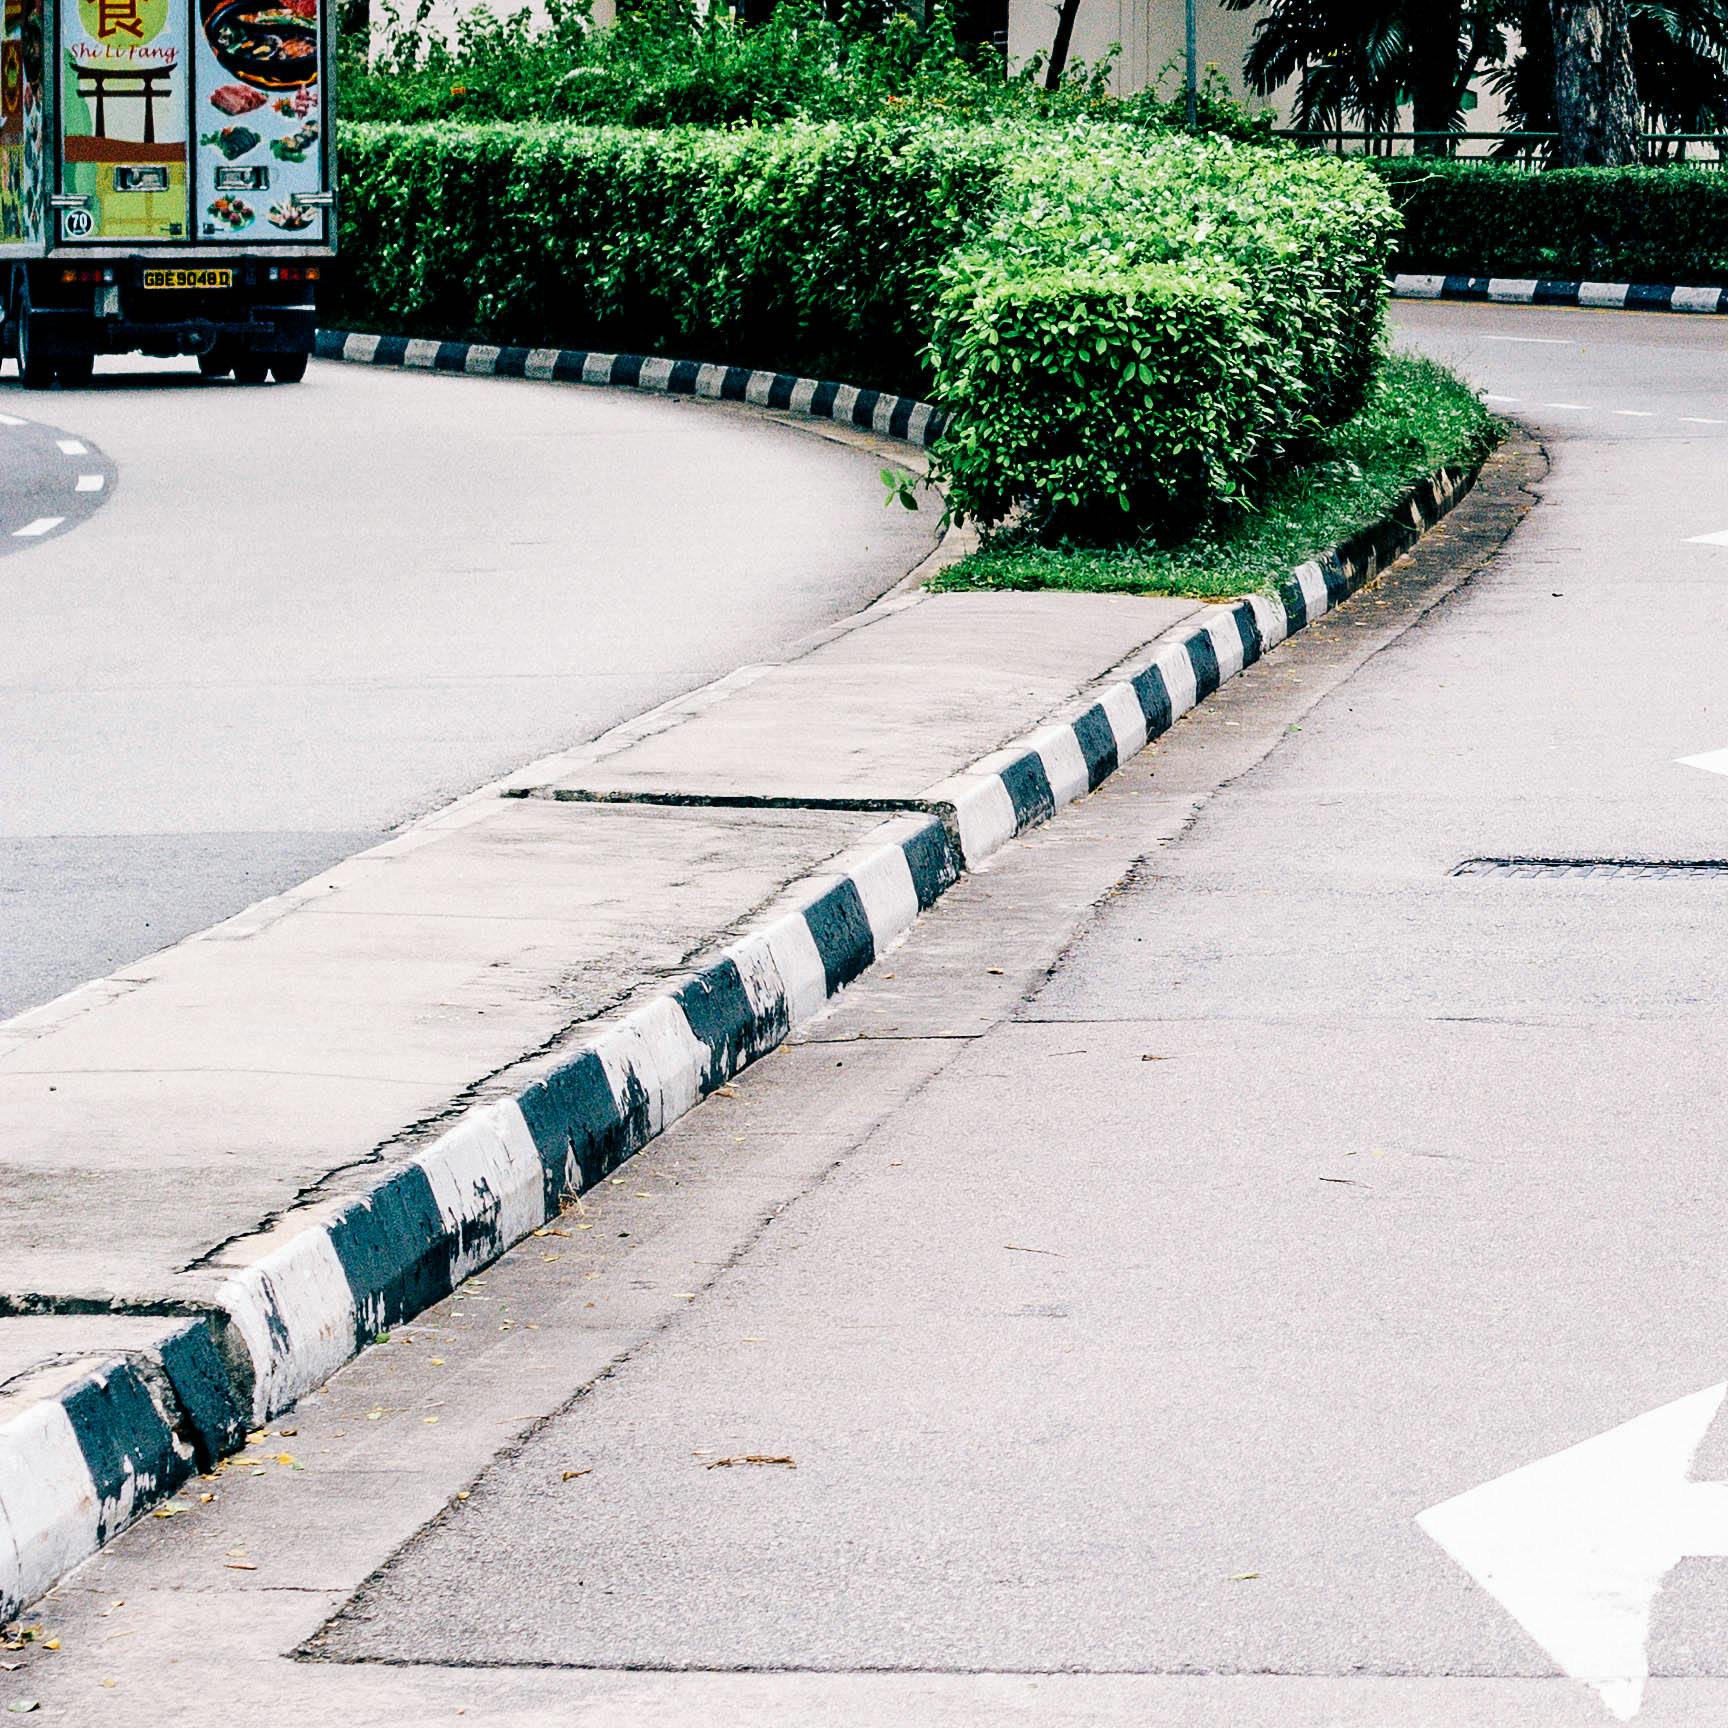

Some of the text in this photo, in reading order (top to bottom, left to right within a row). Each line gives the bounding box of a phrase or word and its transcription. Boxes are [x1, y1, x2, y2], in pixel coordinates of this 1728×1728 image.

[71, 42, 179, 64] Shi Li Fang
[71, 213, 88, 229] 70
